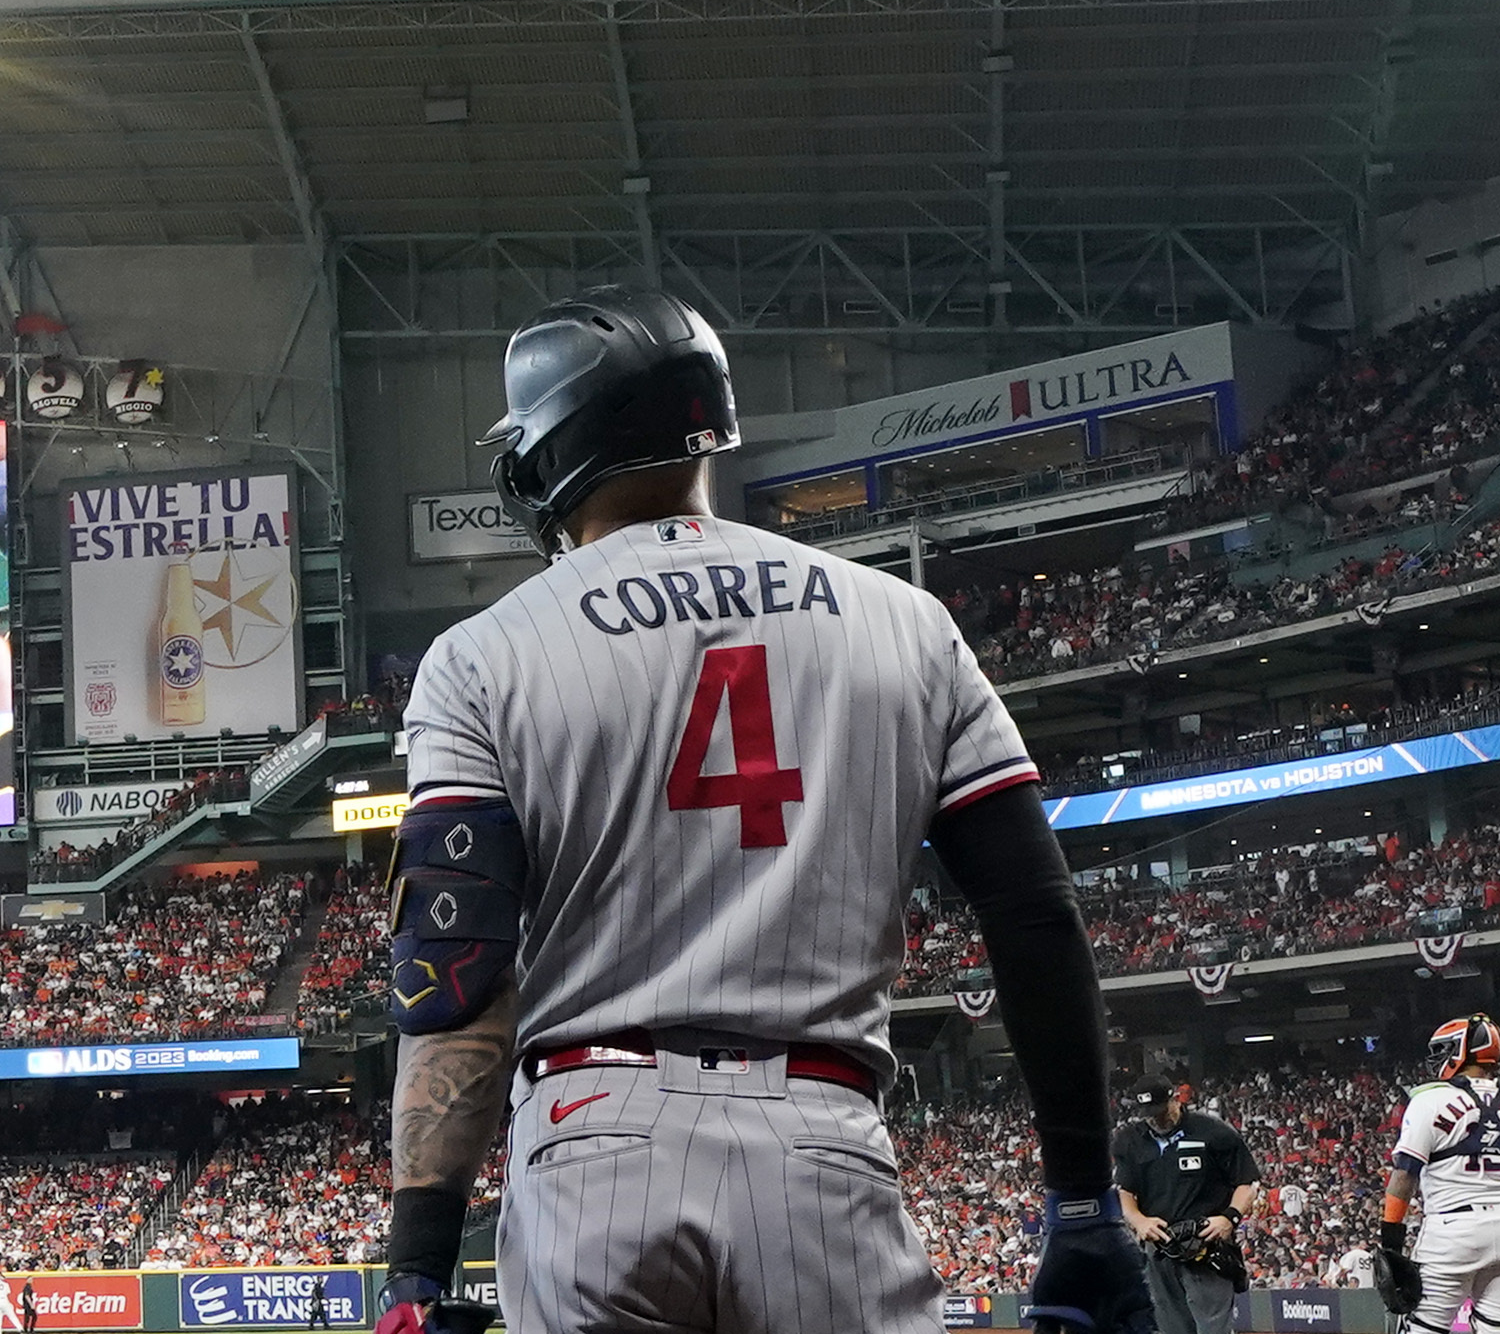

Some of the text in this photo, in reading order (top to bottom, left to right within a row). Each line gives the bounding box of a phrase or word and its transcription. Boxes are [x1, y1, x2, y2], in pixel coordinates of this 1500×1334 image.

[32, 397, 78, 411] BAGWELL
[115, 403, 153, 415] BIGGIO
[871, 351, 1192, 449] Michelob ULTRA
[200, 478, 250, 514] TU
[70, 511, 291, 562] ESTRELLA!
[579, 557, 842, 637] CORREA
[251, 744, 300, 787] KILLEN'S
[666, 644, 804, 850] 4
[1140, 778, 1258, 811] MINNESOTA
[1284, 755, 1384, 787] HOUSTON
[64, 1048, 133, 1073] ALDS
[135, 1051, 185, 1065] 2023
[1282, 1299, 1331, 1321] Booking.com
